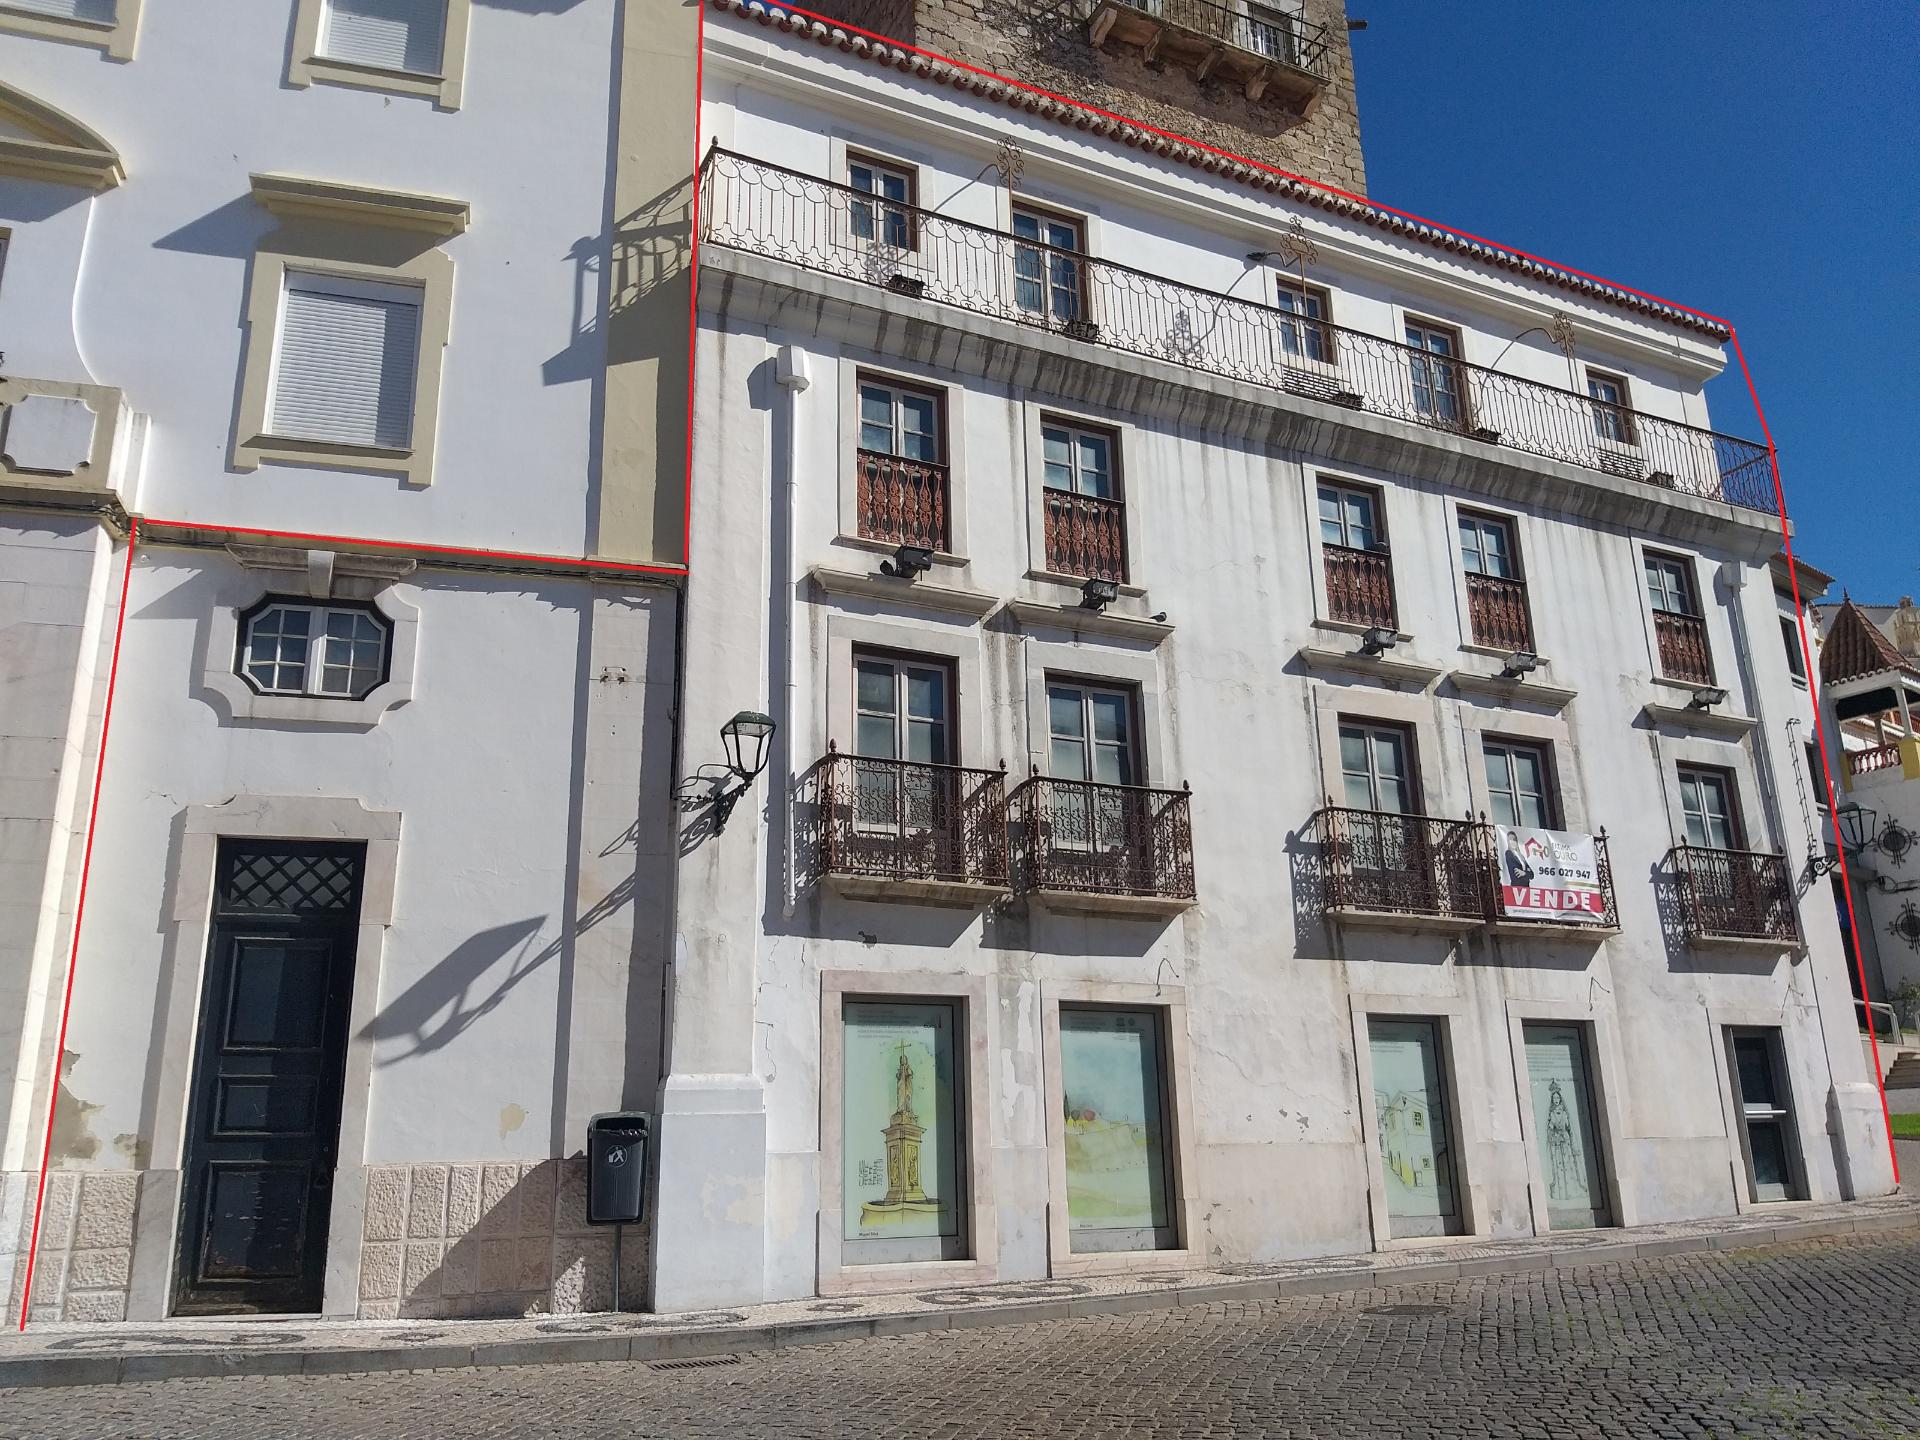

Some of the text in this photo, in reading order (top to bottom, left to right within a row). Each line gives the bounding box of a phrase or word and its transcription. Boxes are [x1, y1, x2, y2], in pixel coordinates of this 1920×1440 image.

[1538, 866, 1591, 880] 966 027 947
[1511, 886, 1591, 911] VENDE
